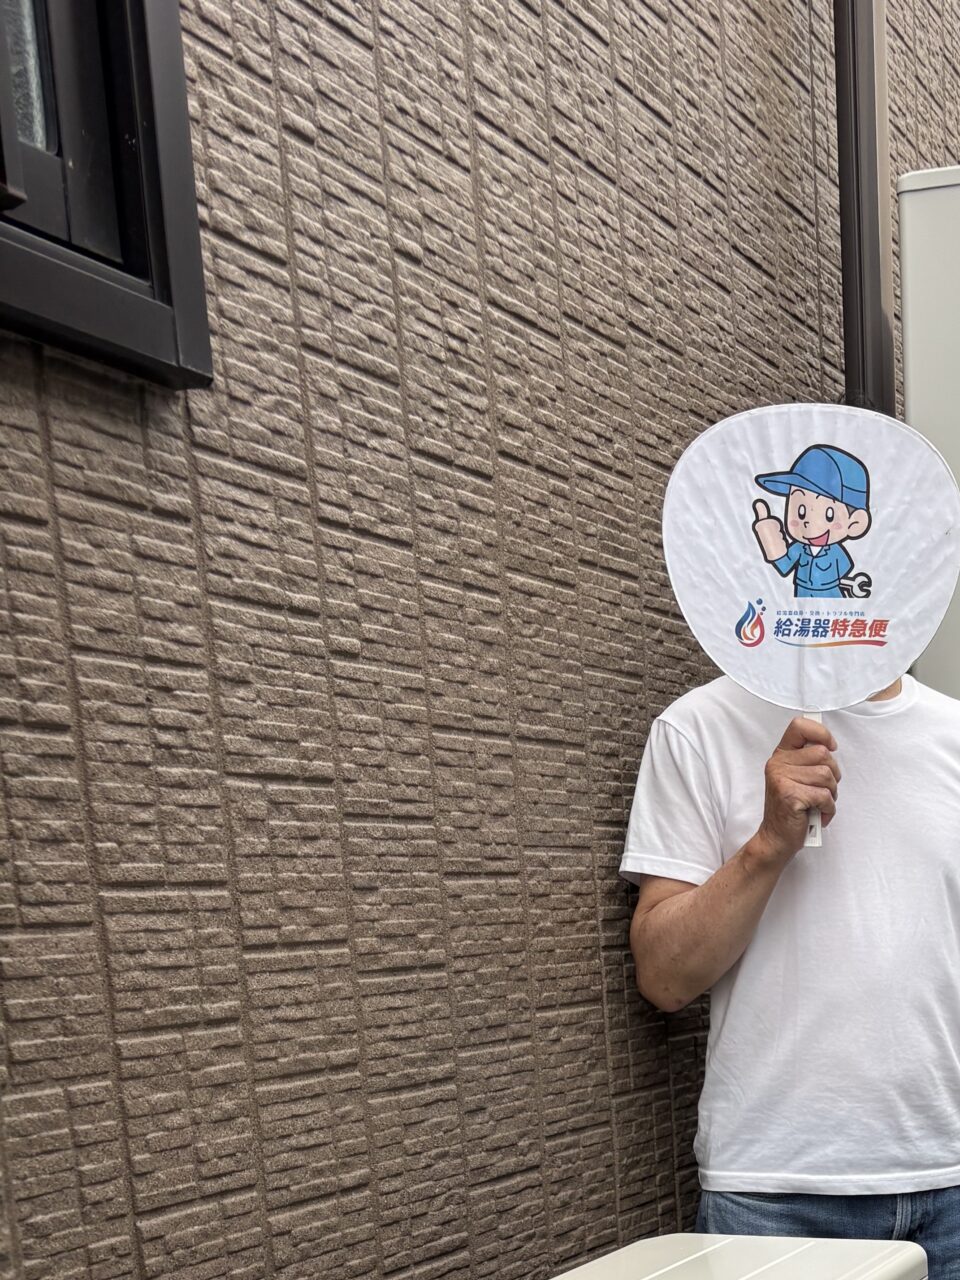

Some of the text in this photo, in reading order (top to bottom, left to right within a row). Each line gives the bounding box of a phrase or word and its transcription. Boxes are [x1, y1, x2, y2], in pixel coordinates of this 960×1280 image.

[773, 617, 890, 638] 給湯器特急便
